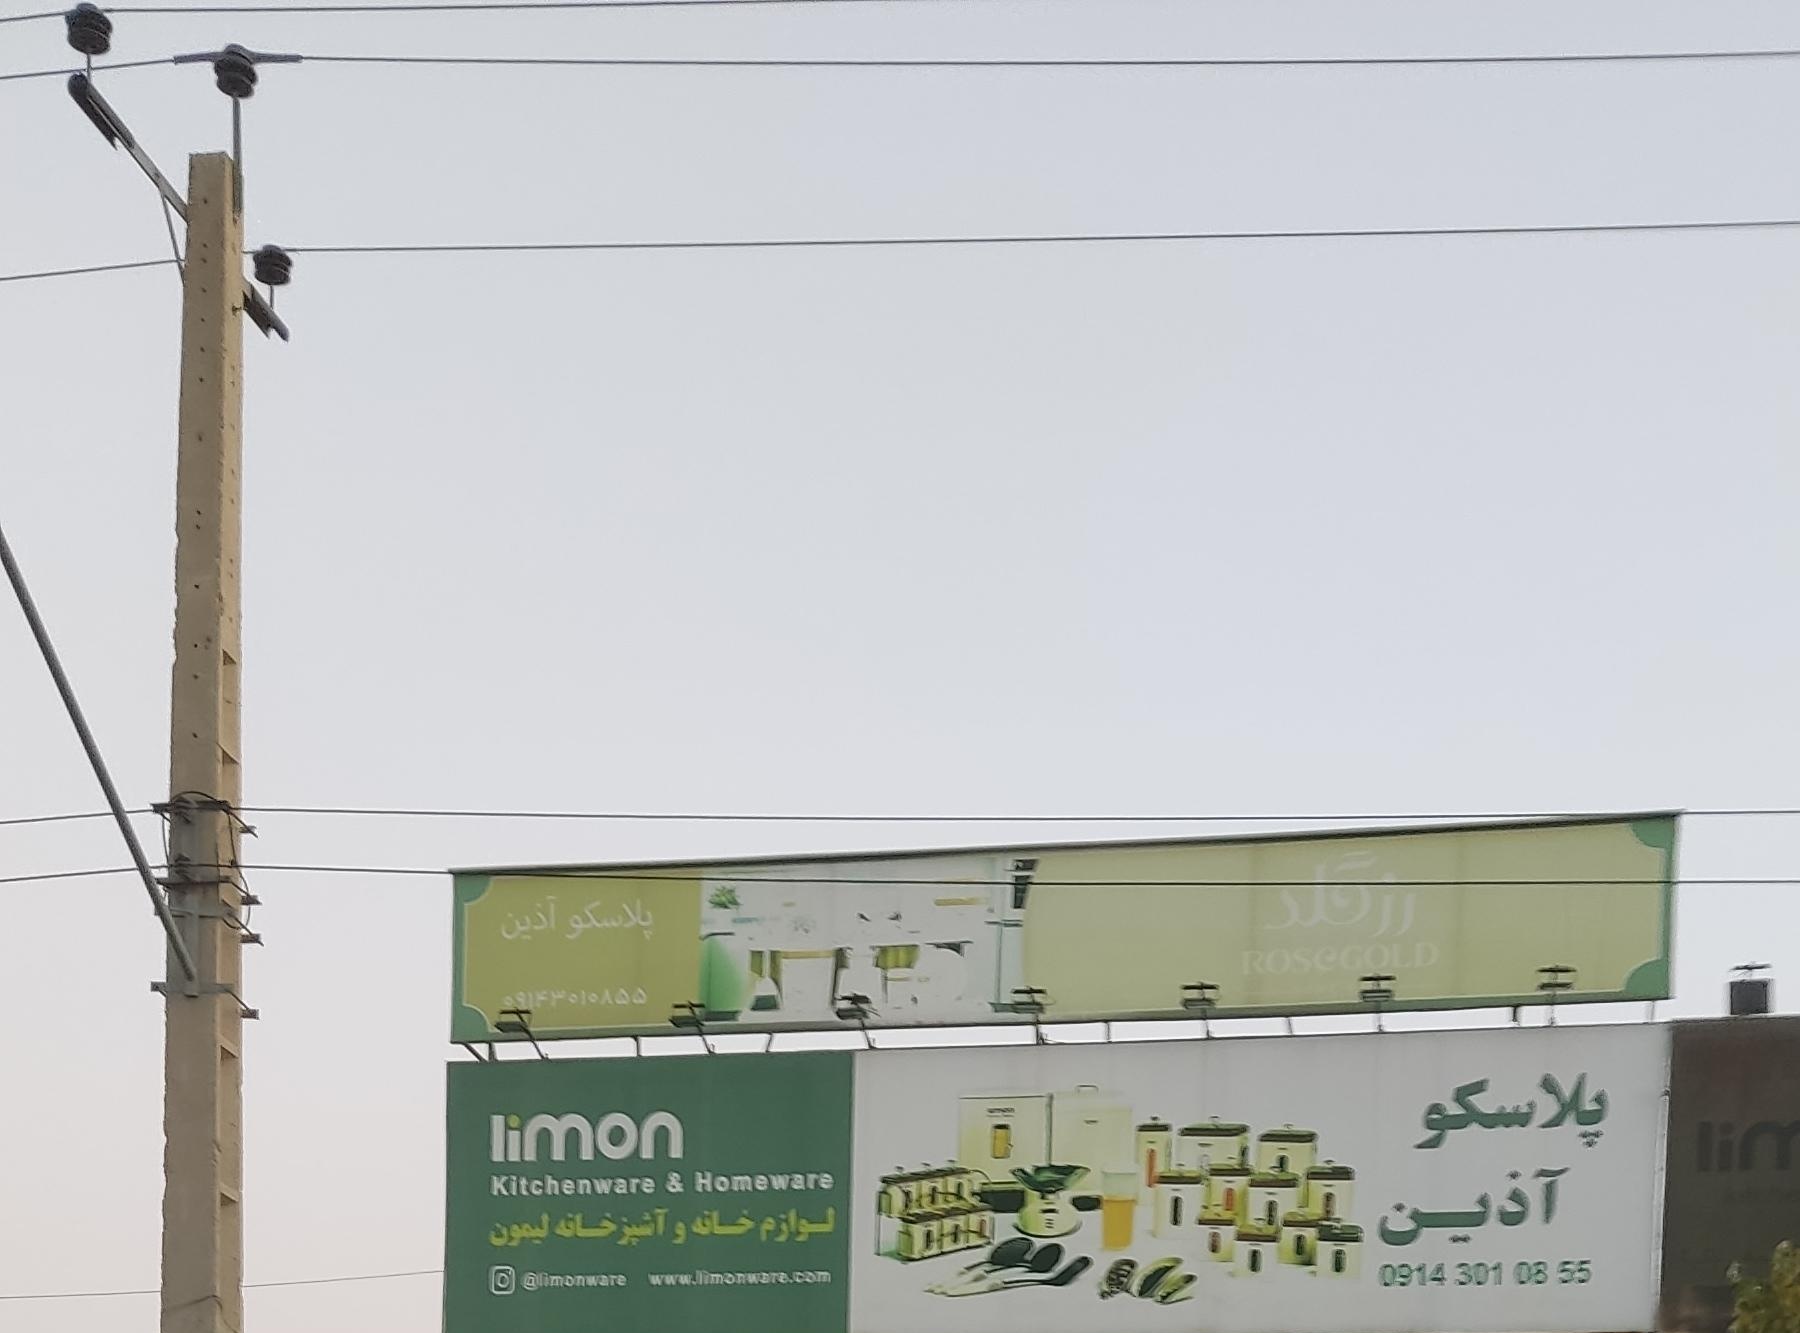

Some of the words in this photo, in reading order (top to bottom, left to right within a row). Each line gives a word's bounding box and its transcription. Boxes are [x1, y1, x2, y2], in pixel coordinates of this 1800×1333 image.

[501, 895, 557, 940] آذین
[565, 899, 653, 940] پلاسکو
[1412, 1072, 1608, 1149] پلاسکو
[489, 1111, 684, 1162] limon
[1696, 1121, 1800, 1172] lim
[490, 1174, 655, 1196] Kitchenware
[665, 1172, 684, 1193] &
[695, 1171, 834, 1192] Homeware
[692, 1210, 754, 1237] خانه
[1379, 1167, 1571, 1246] آذین
[488, 1212, 550, 1247] لیمون
[672, 1220, 687, 1244] و
[759, 1206, 835, 1244] لوازم
[522, 1271, 627, 1290] @limonware
[648, 1268, 832, 1288] www.limonware.com
[1379, 1262, 1447, 1287] 0914
[1455, 1261, 1503, 1286] 301
[1514, 1260, 1549, 1285] 08
[1557, 1259, 1592, 1284] 55
